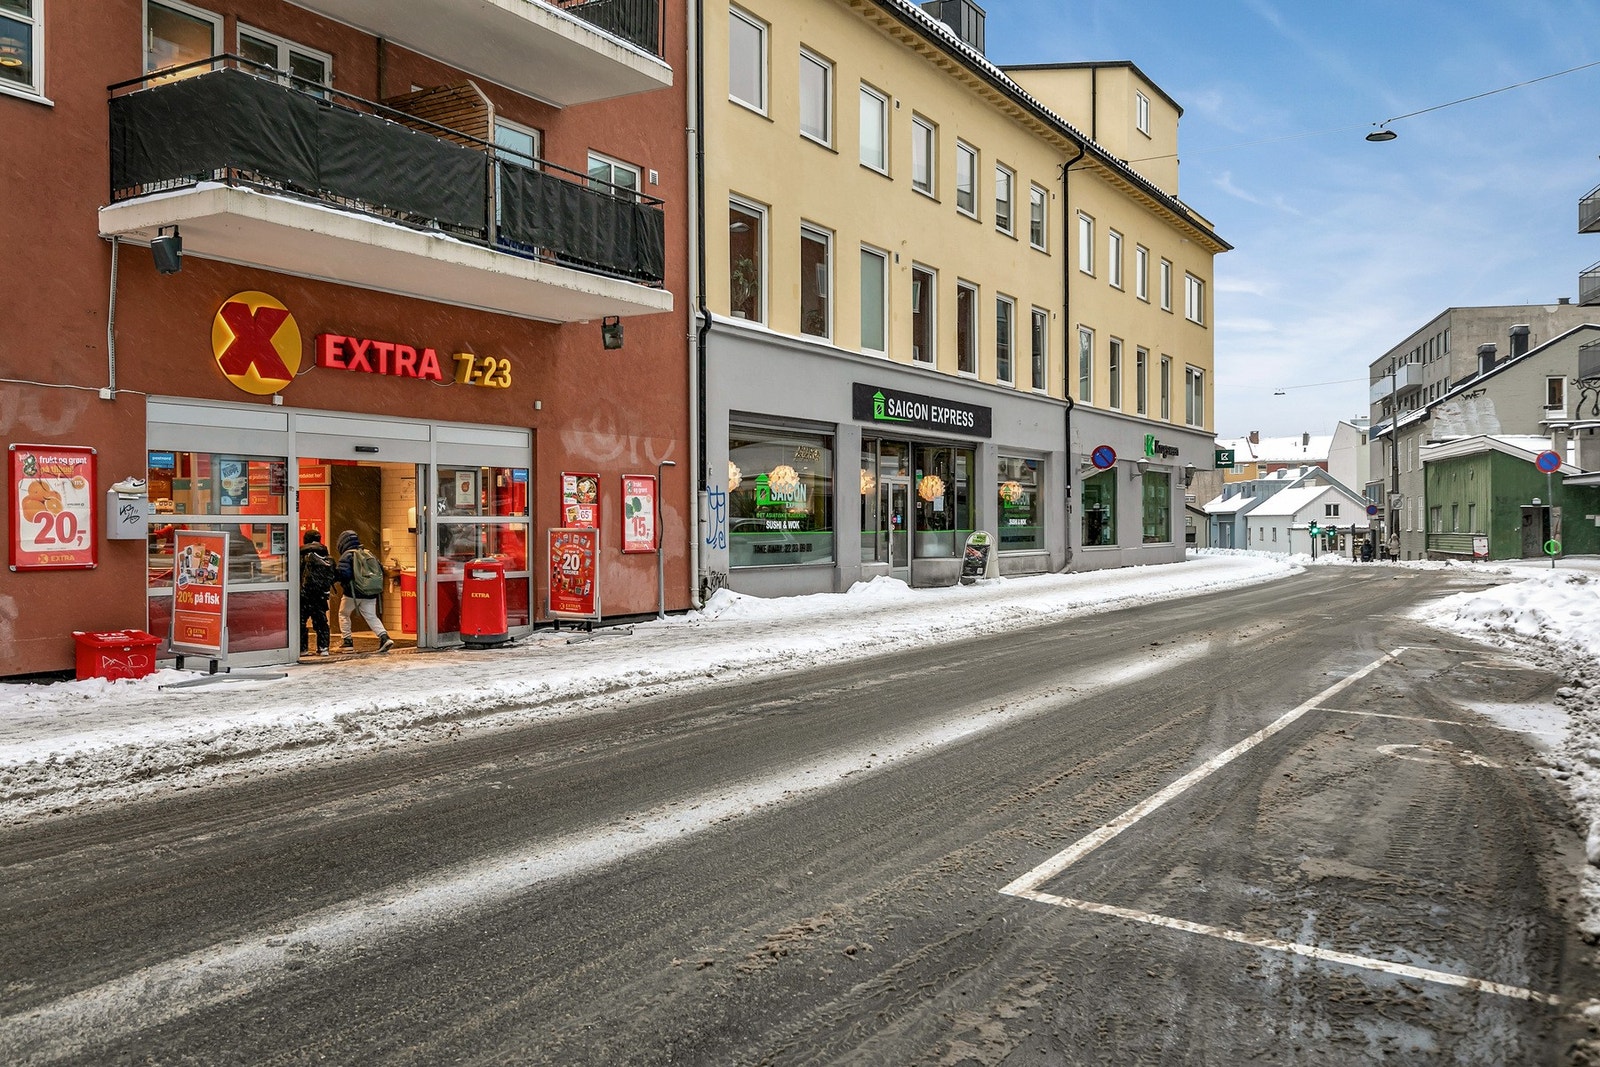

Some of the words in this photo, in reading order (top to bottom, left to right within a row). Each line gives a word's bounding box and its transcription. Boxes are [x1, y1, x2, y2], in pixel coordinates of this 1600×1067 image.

[319, 333, 443, 380] EXTRA
[453, 352, 512, 388] 7-23
[888, 398, 929, 421] SAIGON
[931, 405, 974, 428] EXPRESS
[39, 455, 58, 464] frukt
[766, 520, 782, 529] SUSHI
[782, 520, 787, 529] &
[787, 520, 800, 529] WOK
[561, 553, 580, 571] 20
[177, 591, 194, 604] -20%
[194, 592, 205, 606] på
[204, 592, 220, 605] fisk
